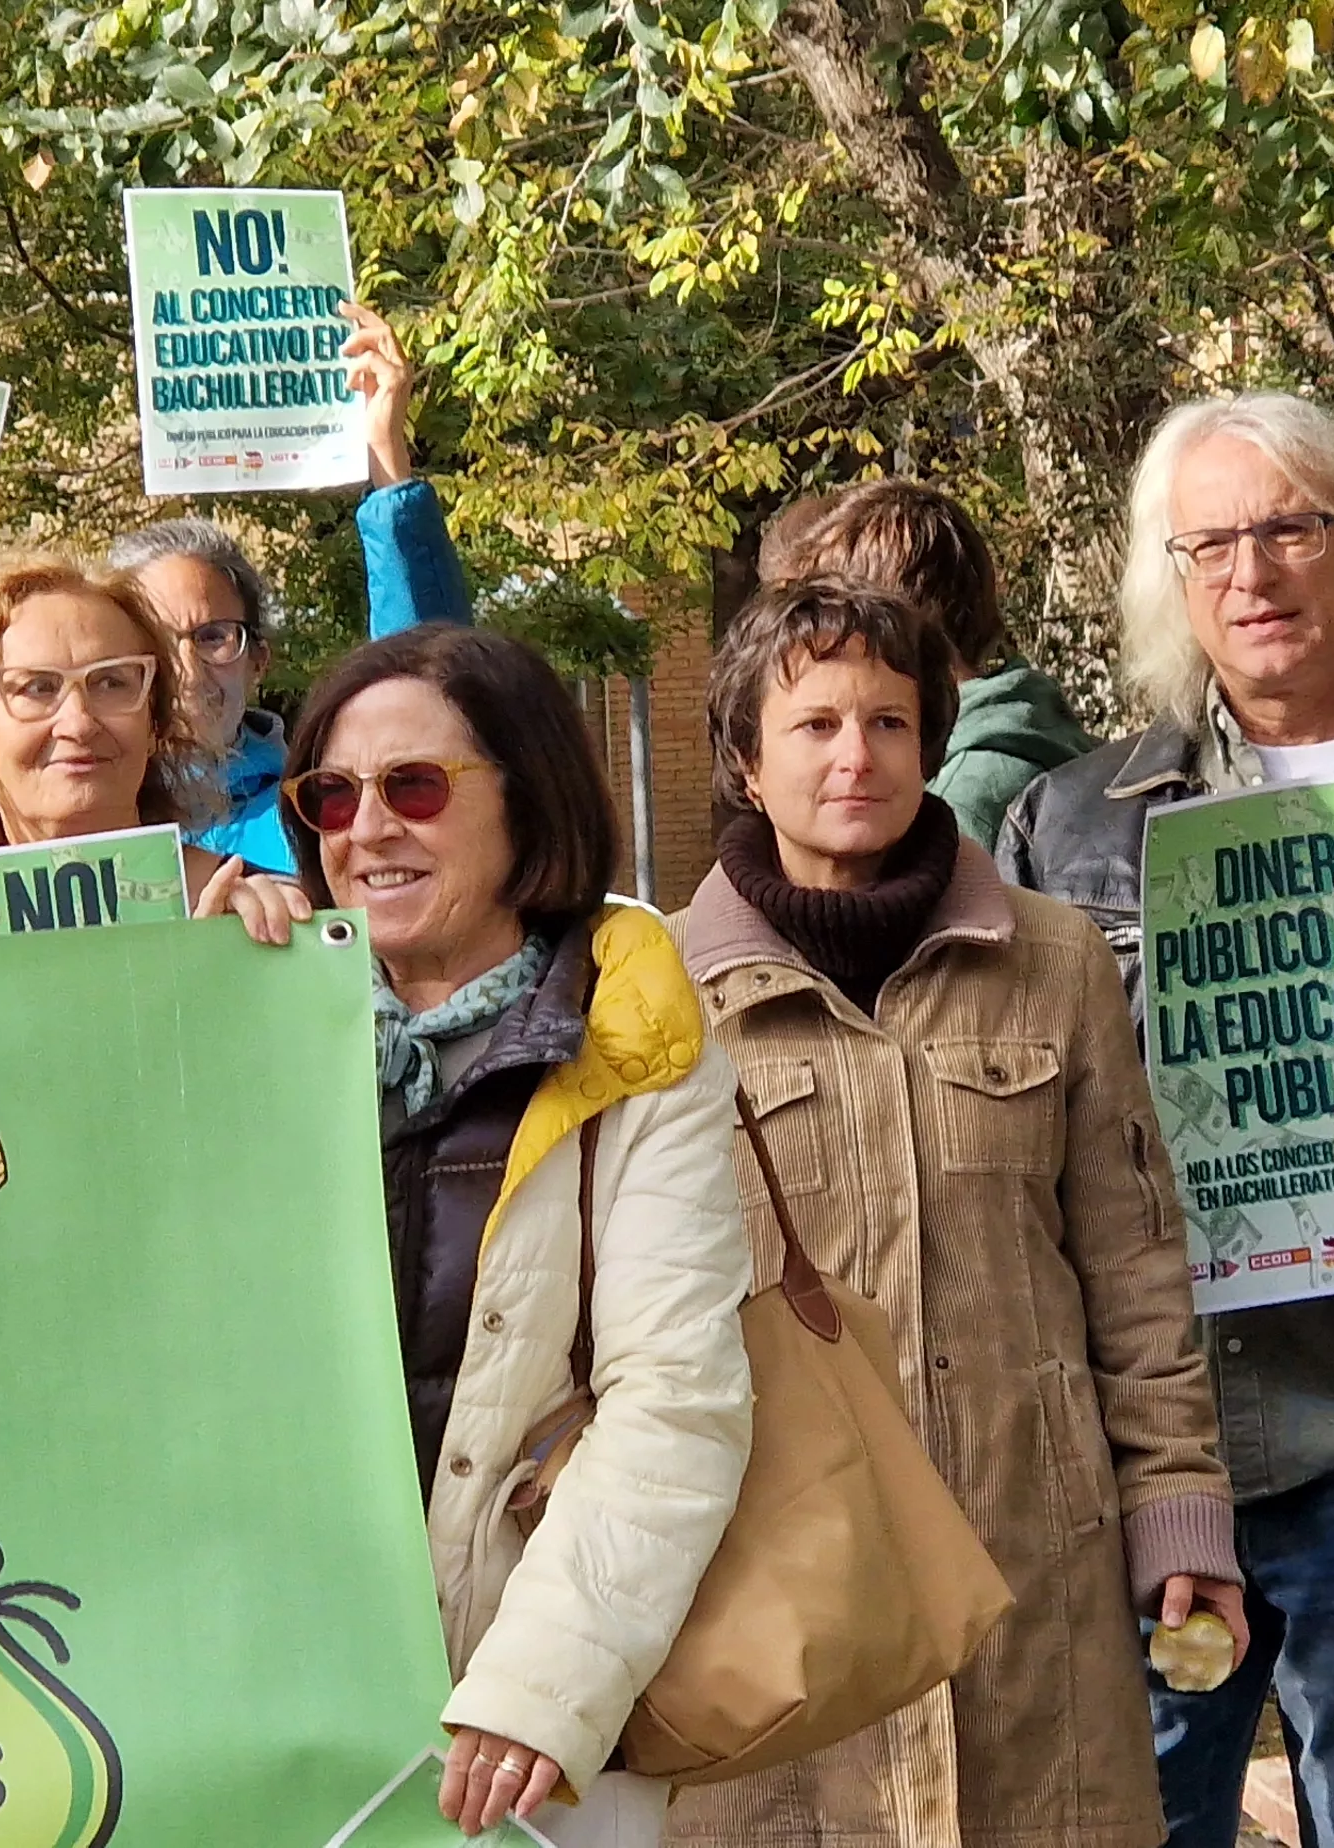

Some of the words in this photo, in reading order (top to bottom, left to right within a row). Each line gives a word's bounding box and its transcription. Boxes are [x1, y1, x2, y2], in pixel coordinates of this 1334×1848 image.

[193, 208, 289, 277] NO!
[153, 290, 188, 326] AL
[190, 285, 345, 324] CONCIERTO
[154, 326, 311, 368] EDUCATIVO
[314, 325, 351, 362] EN
[151, 369, 355, 413] BACHILLERATO
[232, 428, 252, 440] PARA
[254, 428, 263, 439] LA
[1155, 906, 1334, 994] PÚBLICO
[1158, 998, 1209, 1066] LA
[1186, 1160, 1210, 1185] NO
[1214, 1157, 1224, 1182] A
[1226, 1152, 1259, 1180] LOS
[1196, 1185, 1220, 1212] EN
